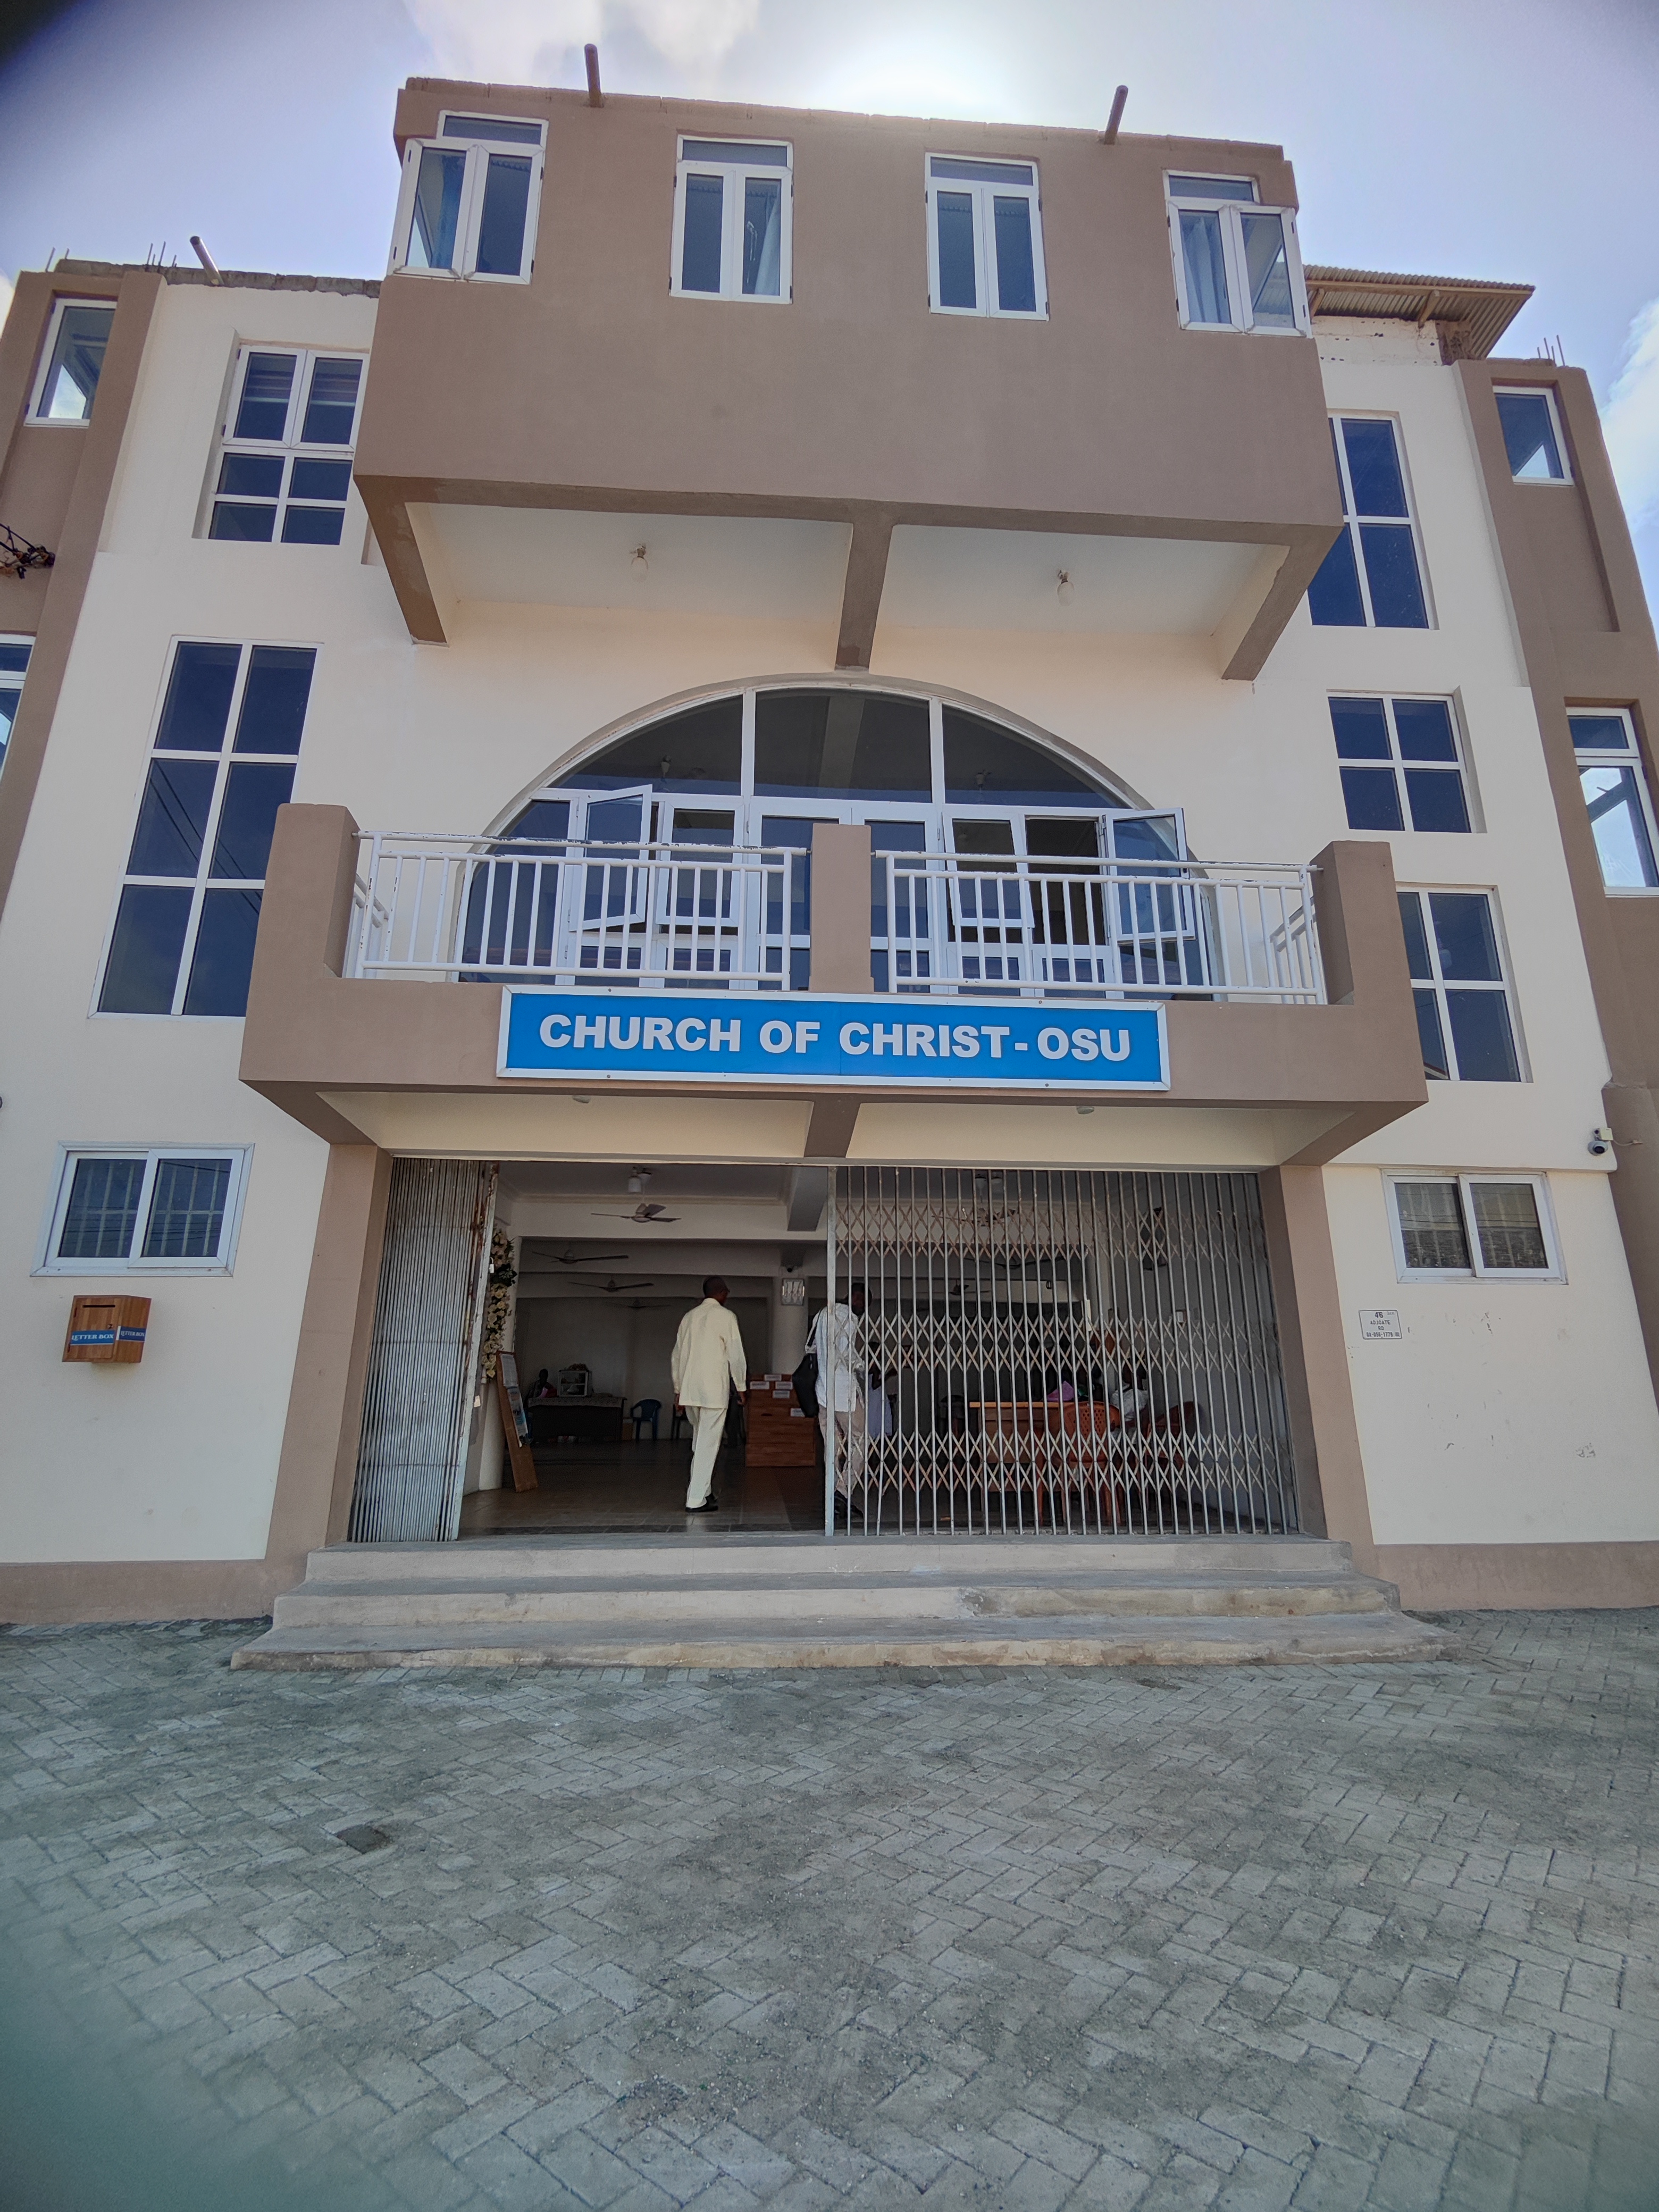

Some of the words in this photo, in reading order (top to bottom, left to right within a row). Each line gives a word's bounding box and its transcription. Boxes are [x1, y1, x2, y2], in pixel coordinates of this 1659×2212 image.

[540, 1015, 741, 1052] CHURCH
[759, 1021, 820, 1053] OF
[839, 1023, 1010, 1058] CHRIST
[1037, 1028, 1130, 1061] OSU
